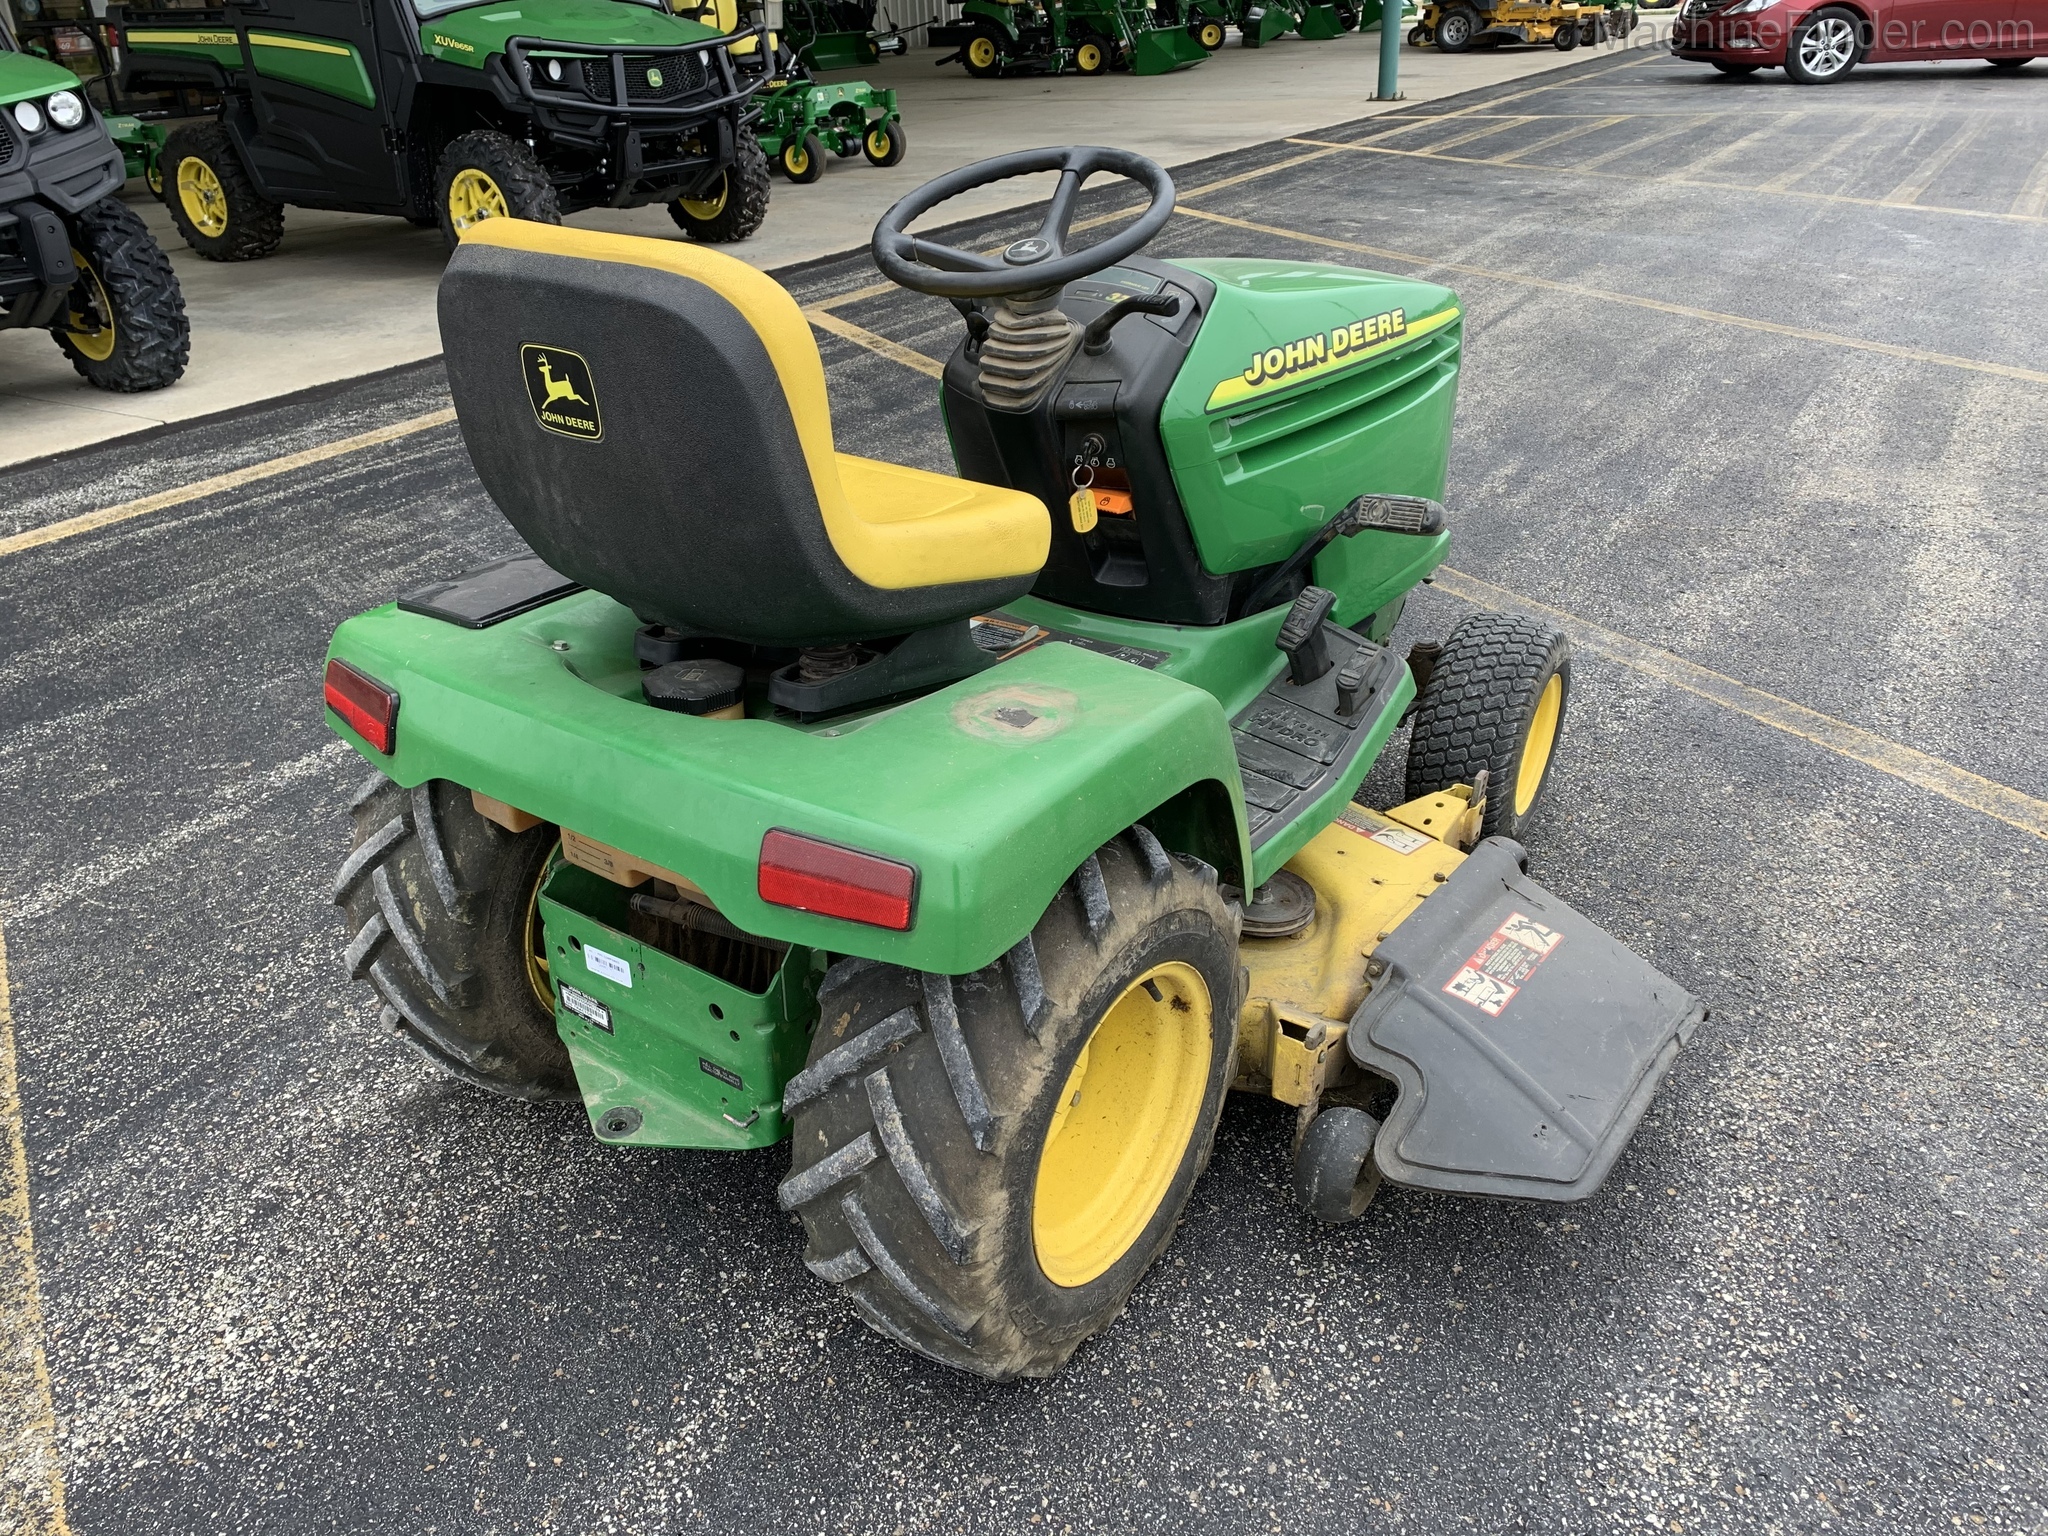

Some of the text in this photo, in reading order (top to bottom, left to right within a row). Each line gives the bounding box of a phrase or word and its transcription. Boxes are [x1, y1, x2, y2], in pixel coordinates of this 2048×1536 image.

[197, 34, 234, 43] JOHN DEERE
[1244, 307, 1407, 385] JOHN DEERE
[541, 410, 596, 431] JOHN DEERE
[1248, 712, 1320, 747] HYDRO
[1293, 720, 1330, 738] TOUCH
